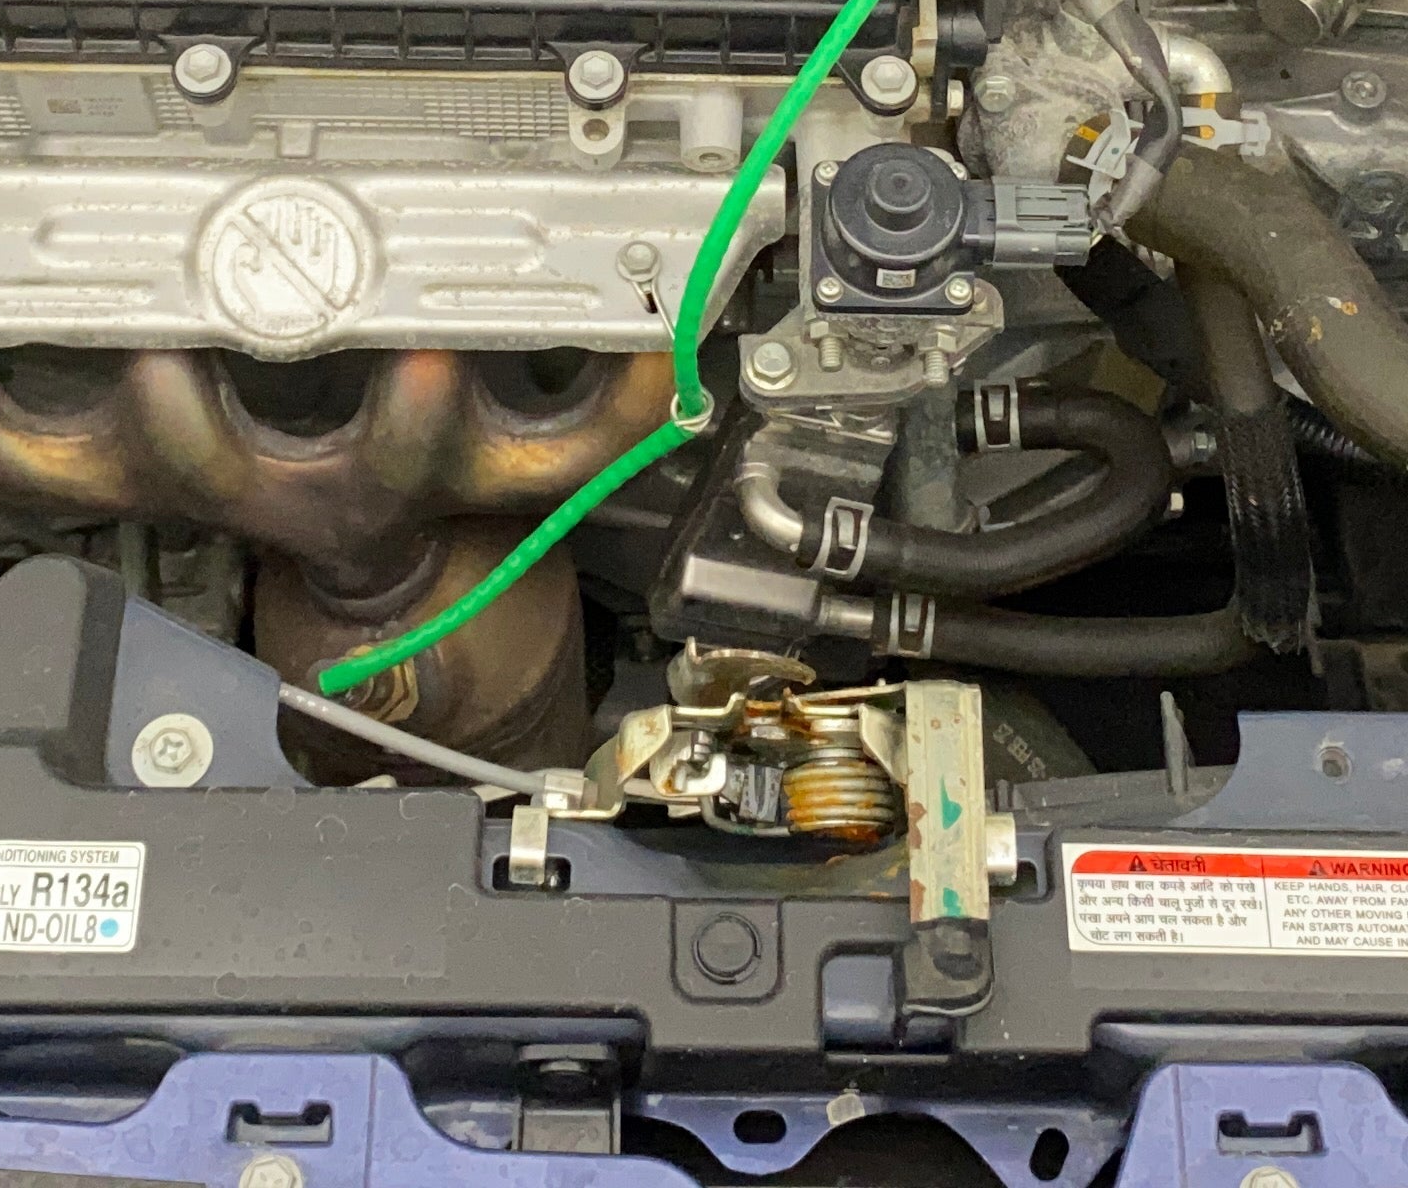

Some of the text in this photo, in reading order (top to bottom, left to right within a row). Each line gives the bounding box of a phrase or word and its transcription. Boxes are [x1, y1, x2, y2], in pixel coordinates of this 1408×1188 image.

[70, 850, 120, 864] SYSTEM
[1149, 855, 1206, 873] चेतावनी
[29, 871, 130, 908] R134a
[1274, 881, 1305, 891] KEEP
[1308, 882, 1353, 893] HANDS,
[1286, 895, 1313, 905] ETC.
[1316, 895, 1349, 905] AWAY
[1352, 896, 1387, 906] FROM
[1283, 909, 1307, 918] ANY
[1311, 909, 1352, 919] OTHER
[1355, 910, 1403, 920] MOVING
[2, 912, 98, 944] ND-OIL8
[1282, 922, 1305, 931] FAN
[1309, 922, 1354, 933] STARTS
[1296, 936, 1321, 945] AND
[1324, 936, 1349, 946] MAY
[1352, 937, 1393, 947] CAUSE
